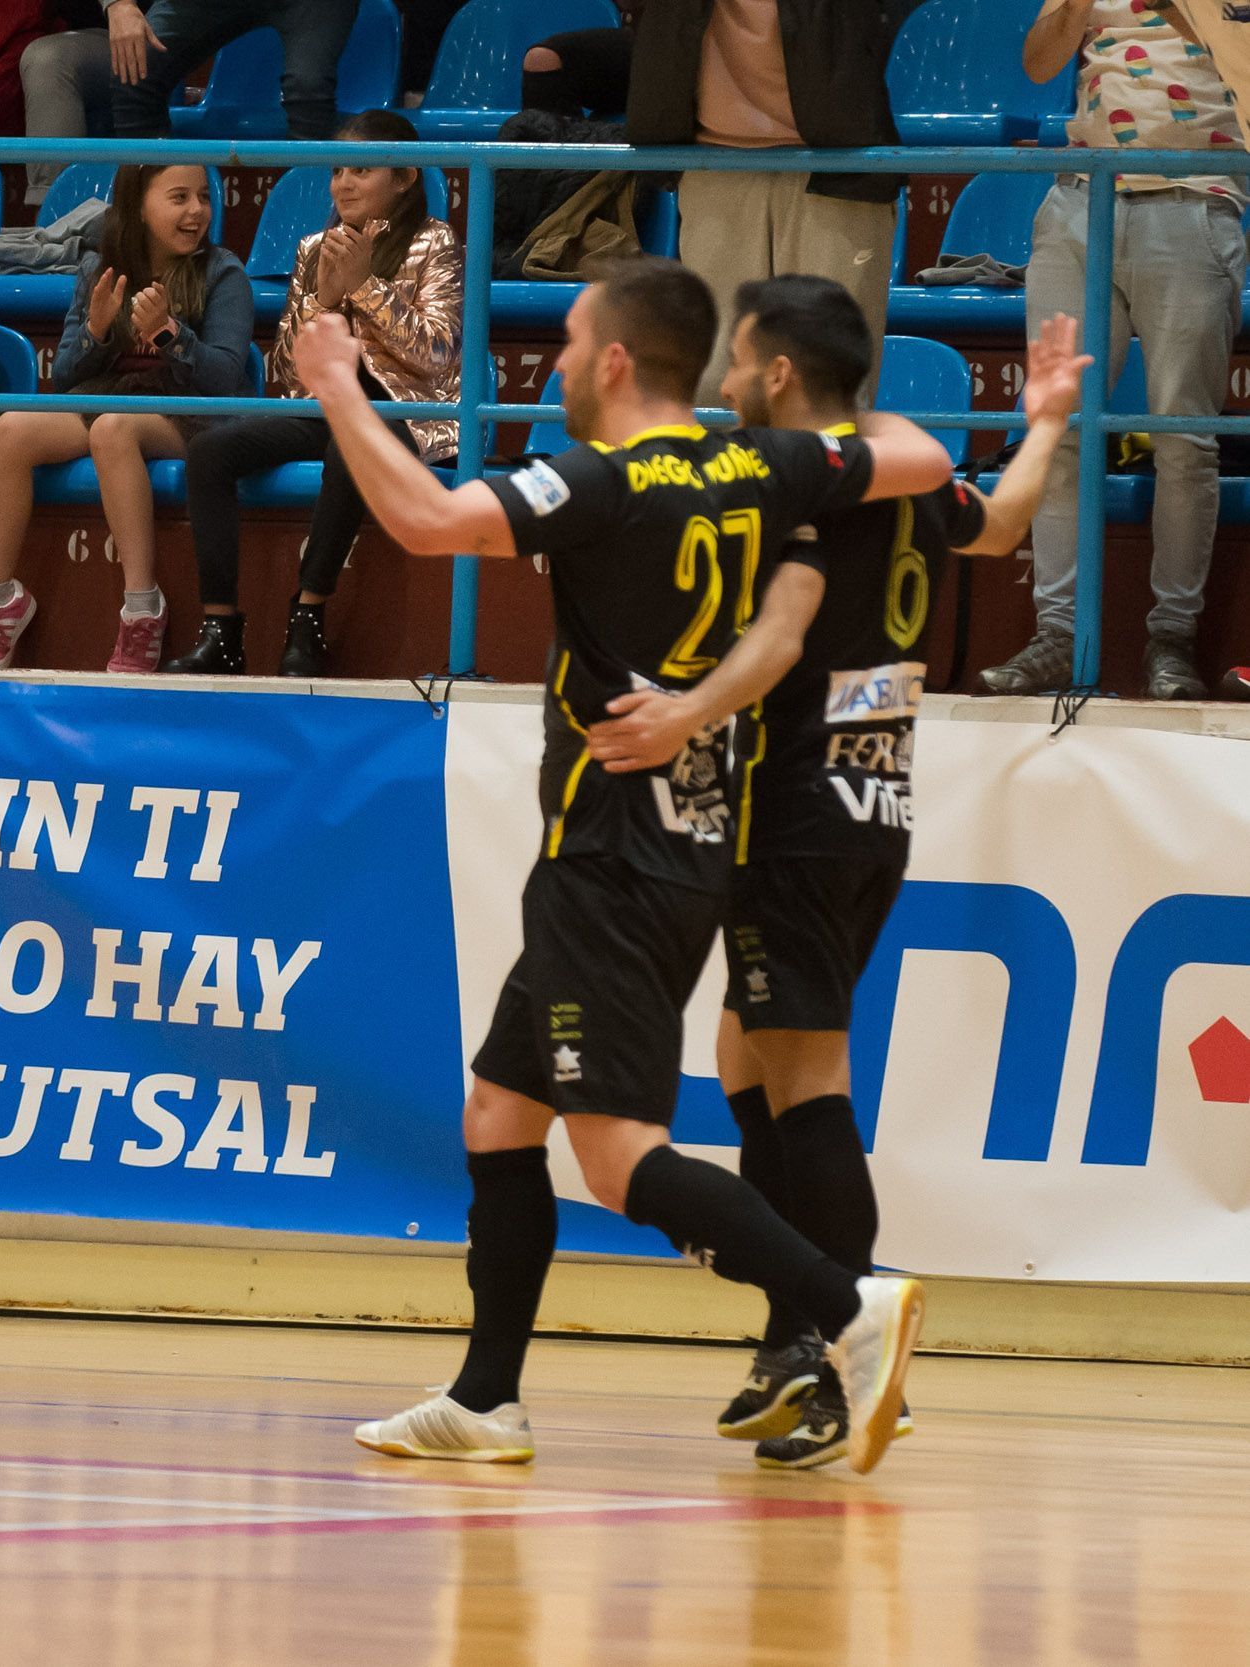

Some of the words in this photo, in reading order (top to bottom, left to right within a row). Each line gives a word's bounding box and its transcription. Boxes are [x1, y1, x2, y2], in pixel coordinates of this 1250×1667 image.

[658, 507, 762, 679] 27
[883, 495, 929, 651] 6
[129, 786, 240, 882] TI
[85, 928, 322, 1032] HAY
